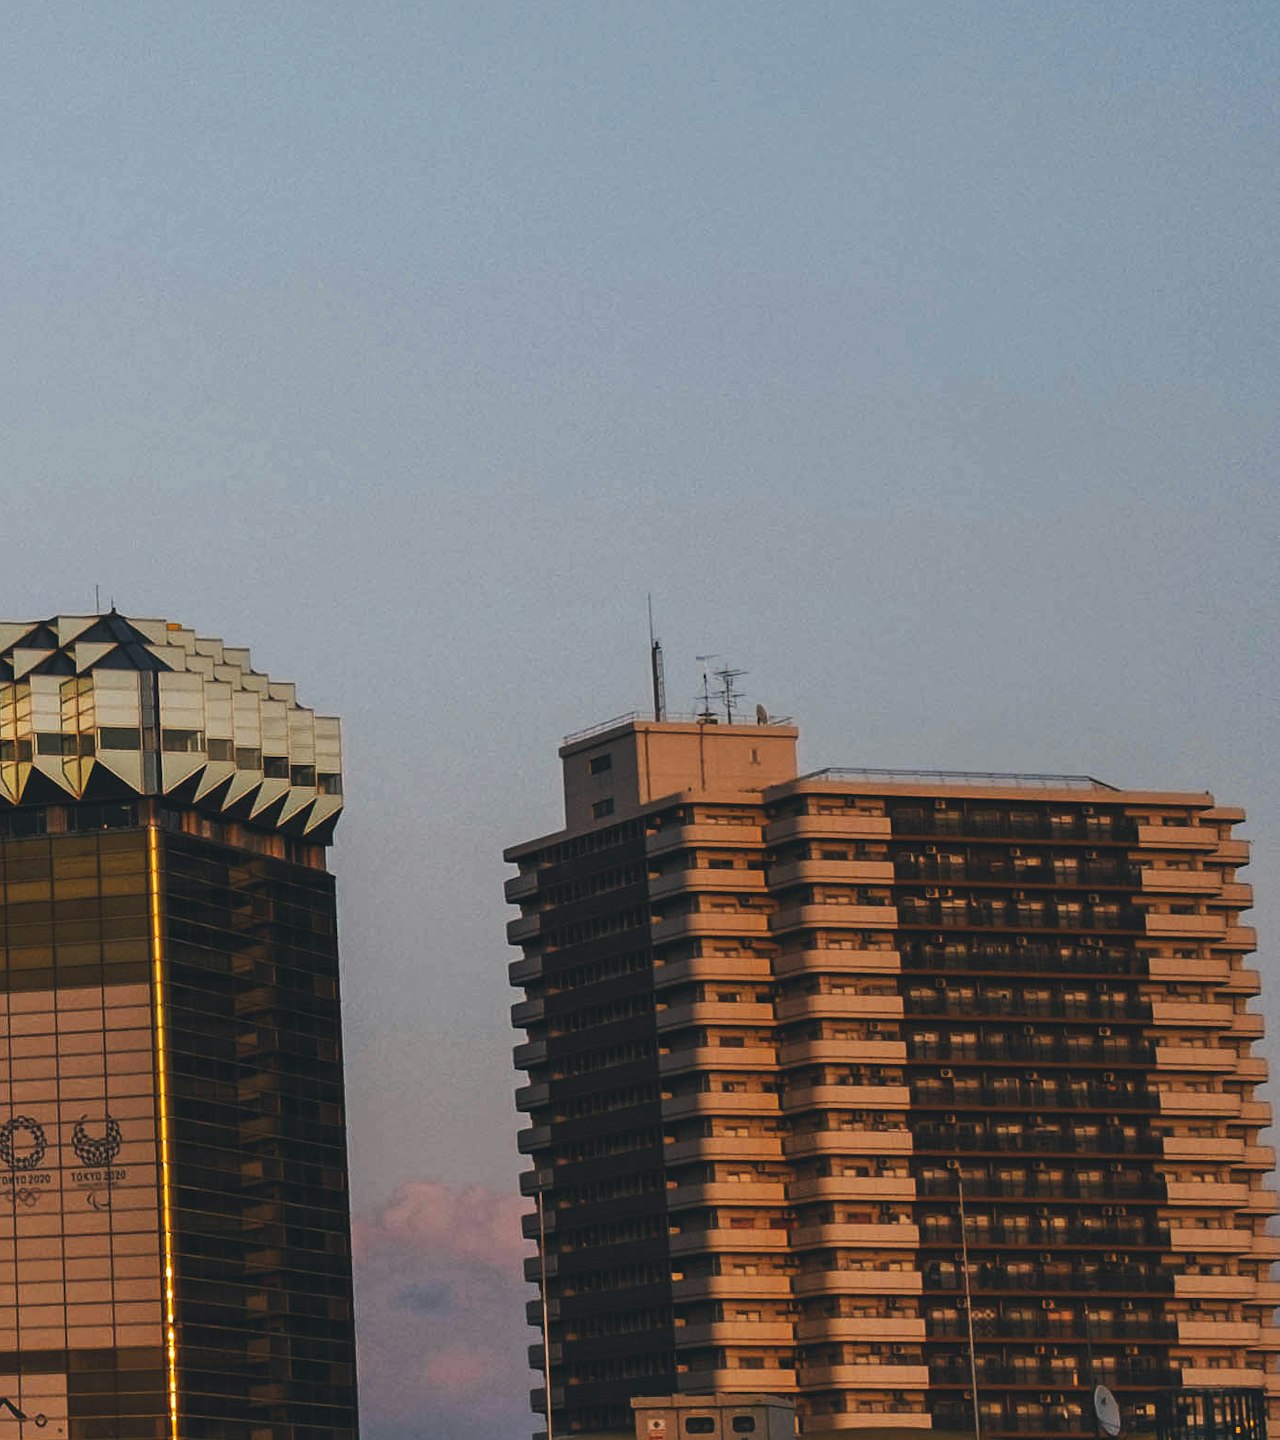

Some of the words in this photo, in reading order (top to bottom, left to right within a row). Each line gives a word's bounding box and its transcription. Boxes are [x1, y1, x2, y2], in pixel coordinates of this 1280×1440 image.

[28, 1173, 51, 1185] 2020
[70, 1171, 101, 1182] TOKYO
[103, 1169, 127, 1181] 2020
